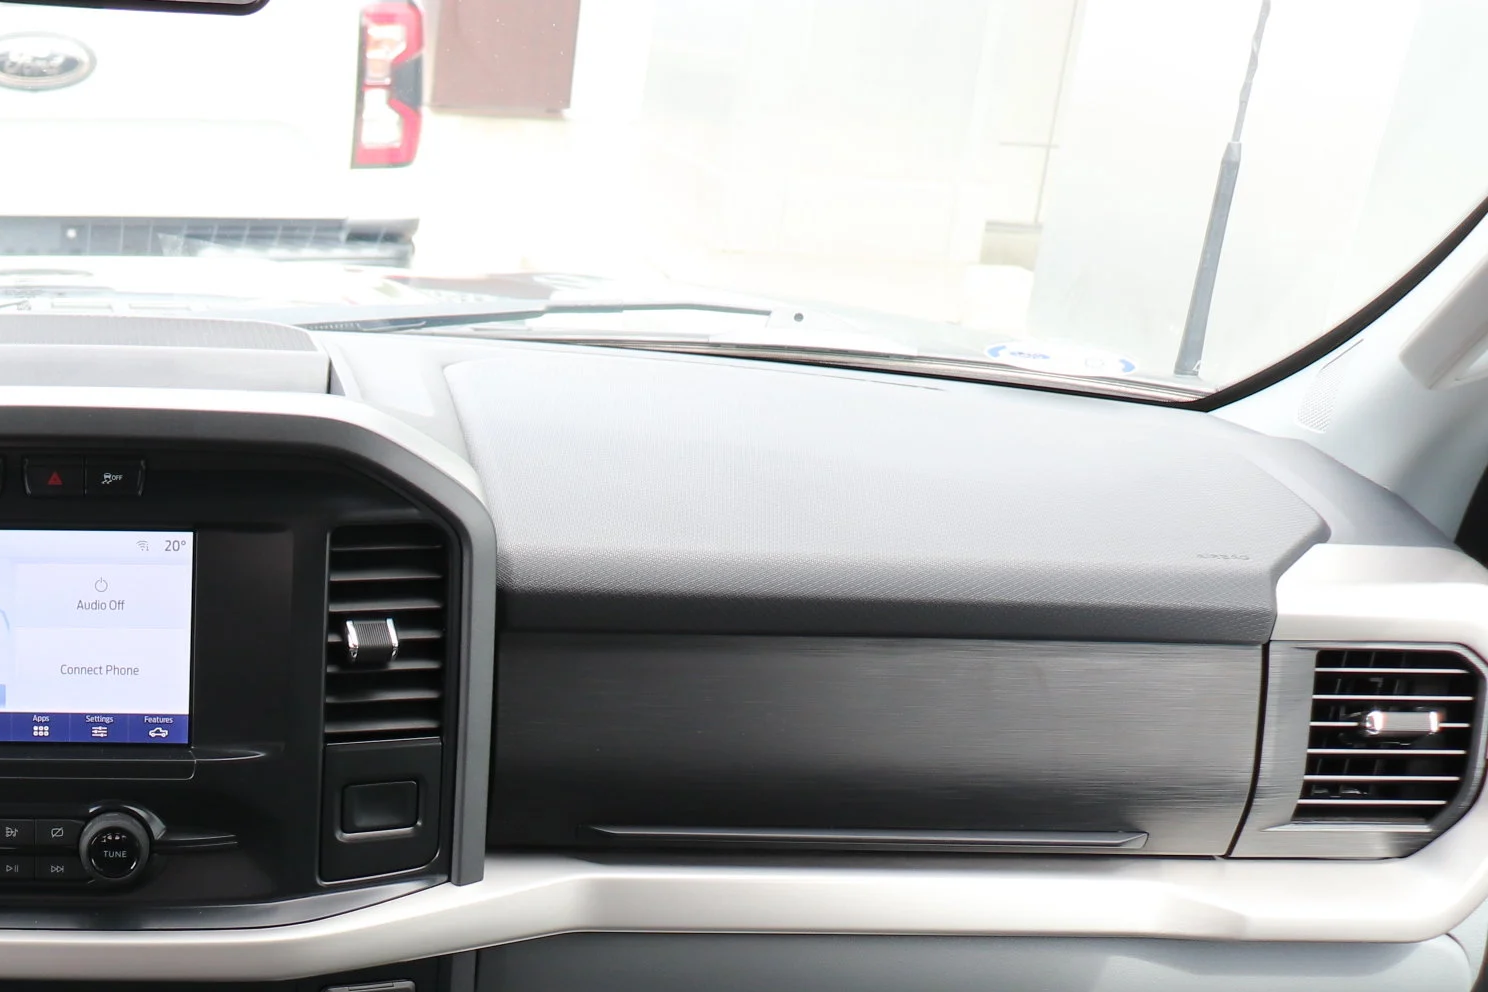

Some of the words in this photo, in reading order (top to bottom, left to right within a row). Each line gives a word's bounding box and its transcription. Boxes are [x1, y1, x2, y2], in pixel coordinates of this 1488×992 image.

[111, 473, 123, 482] OFF
[164, 540, 187, 552] 20°
[76, 599, 107, 611] Audio
[109, 599, 125, 611] Off
[60, 664, 103, 676] Connect
[106, 665, 140, 676] Phone
[32, 715, 50, 723] Apps
[85, 715, 114, 723] Settings
[144, 716, 173, 724] Features
[103, 850, 127, 858] TUNE
